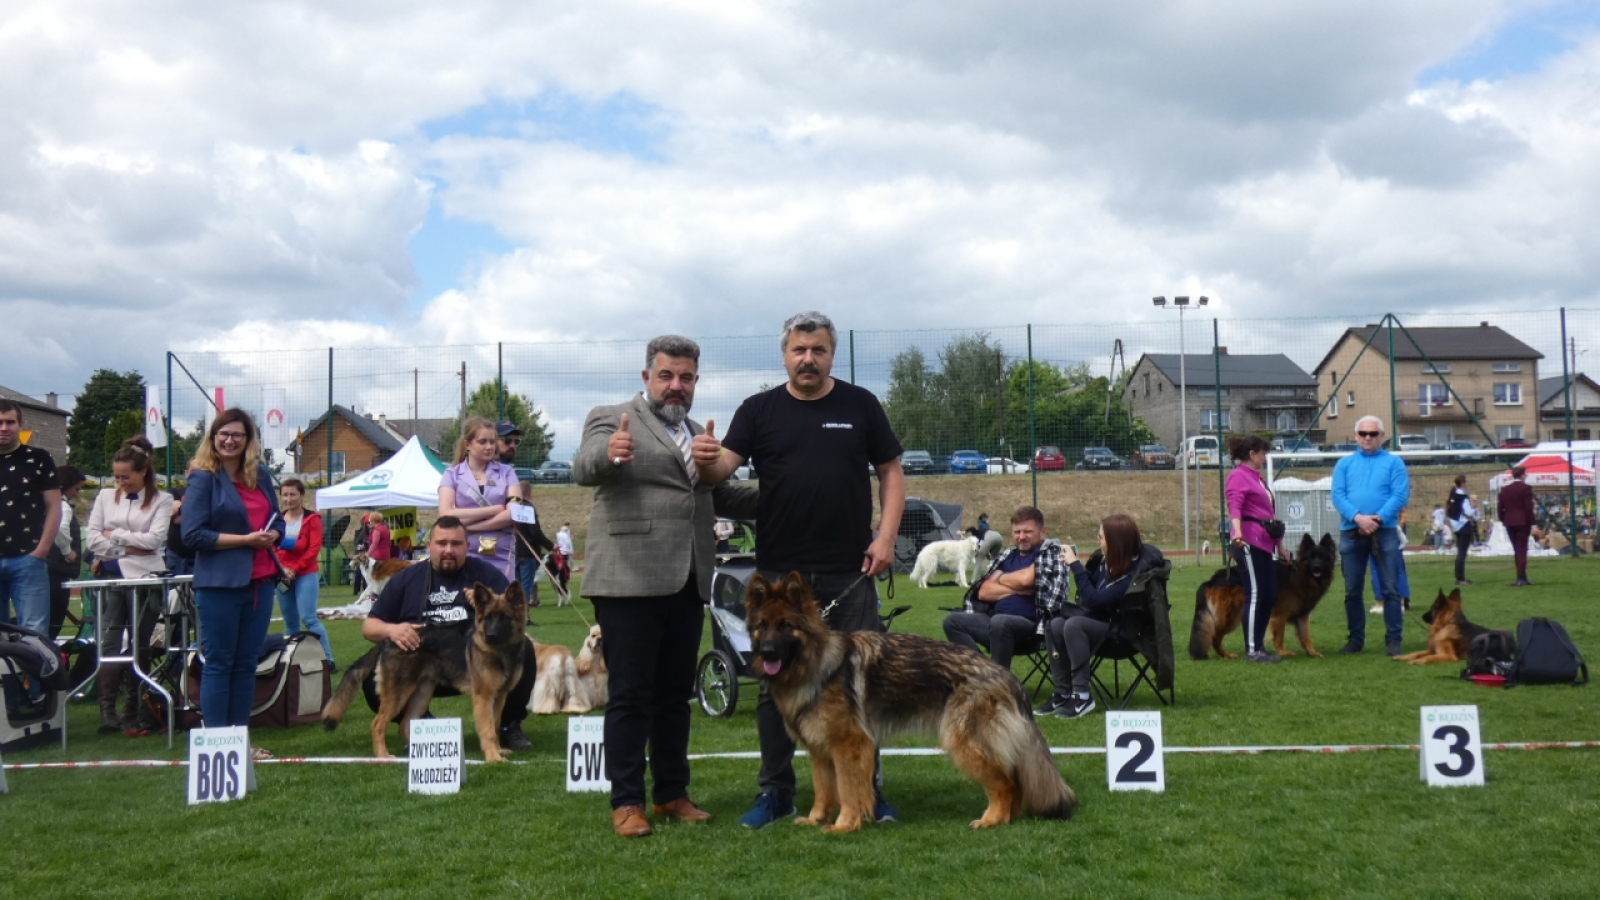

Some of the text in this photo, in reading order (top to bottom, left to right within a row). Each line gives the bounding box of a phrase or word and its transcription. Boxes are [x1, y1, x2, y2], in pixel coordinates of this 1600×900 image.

[1123, 719, 1158, 730] BĘDZIN
[1438, 713, 1475, 724] BĘDZIN
[425, 725, 459, 736] BĘDZIN
[207, 735, 243, 748] BĘDZIN
[411, 741, 459, 761] ZWYCIĘZCA
[1432, 725, 1475, 778] 3
[570, 742, 607, 782] CW
[1114, 731, 1157, 783] 2
[196, 750, 239, 800] BOS
[411, 763, 458, 784] MŁODZIEŻY
